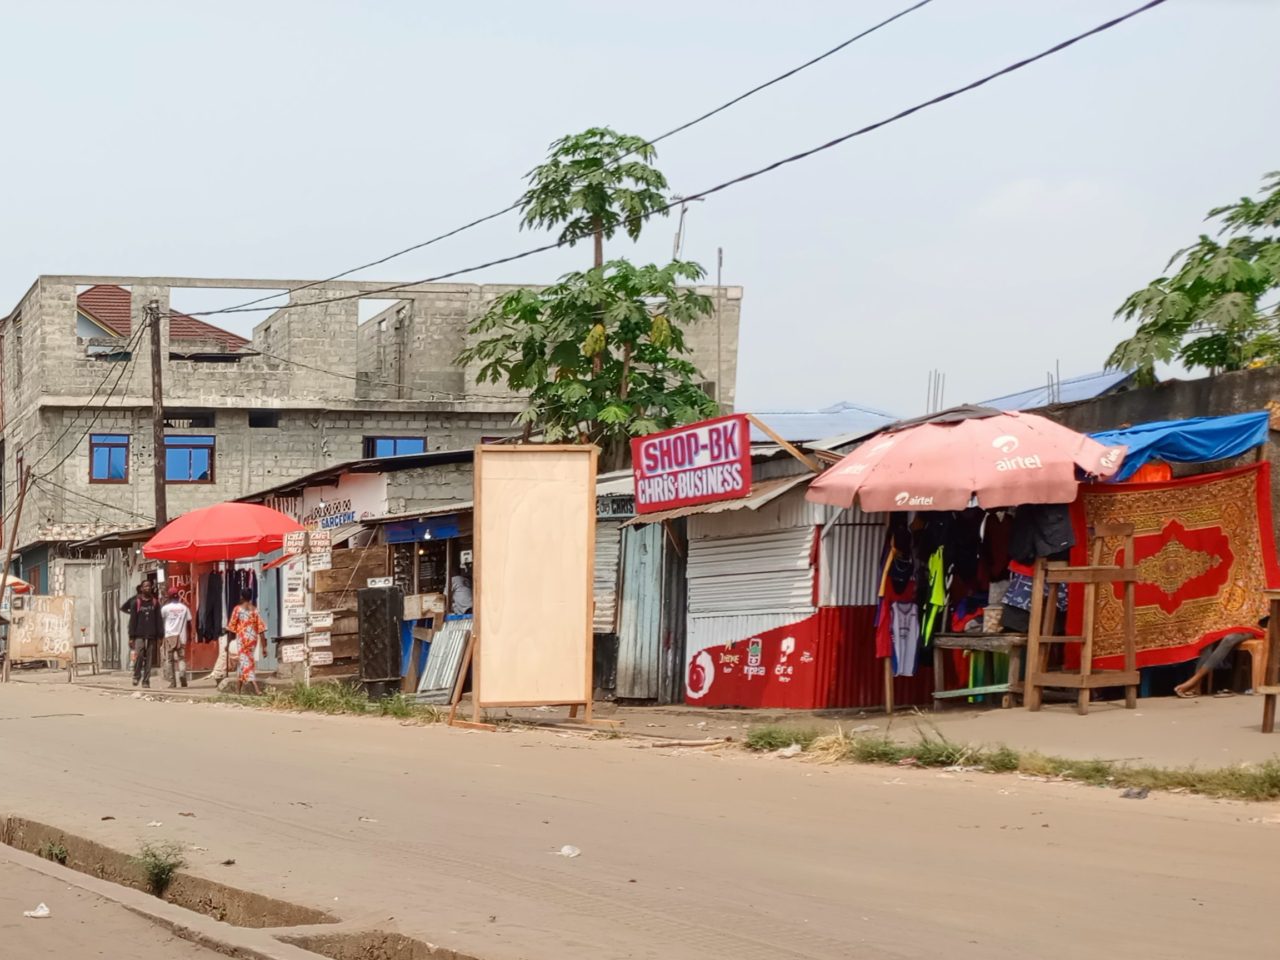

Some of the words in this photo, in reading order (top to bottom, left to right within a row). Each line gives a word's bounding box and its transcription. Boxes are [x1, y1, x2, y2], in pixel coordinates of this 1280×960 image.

[644, 422, 738, 474] SHOP-BK
[995, 454, 1043, 472] airtel
[909, 495, 934, 506] airtel
